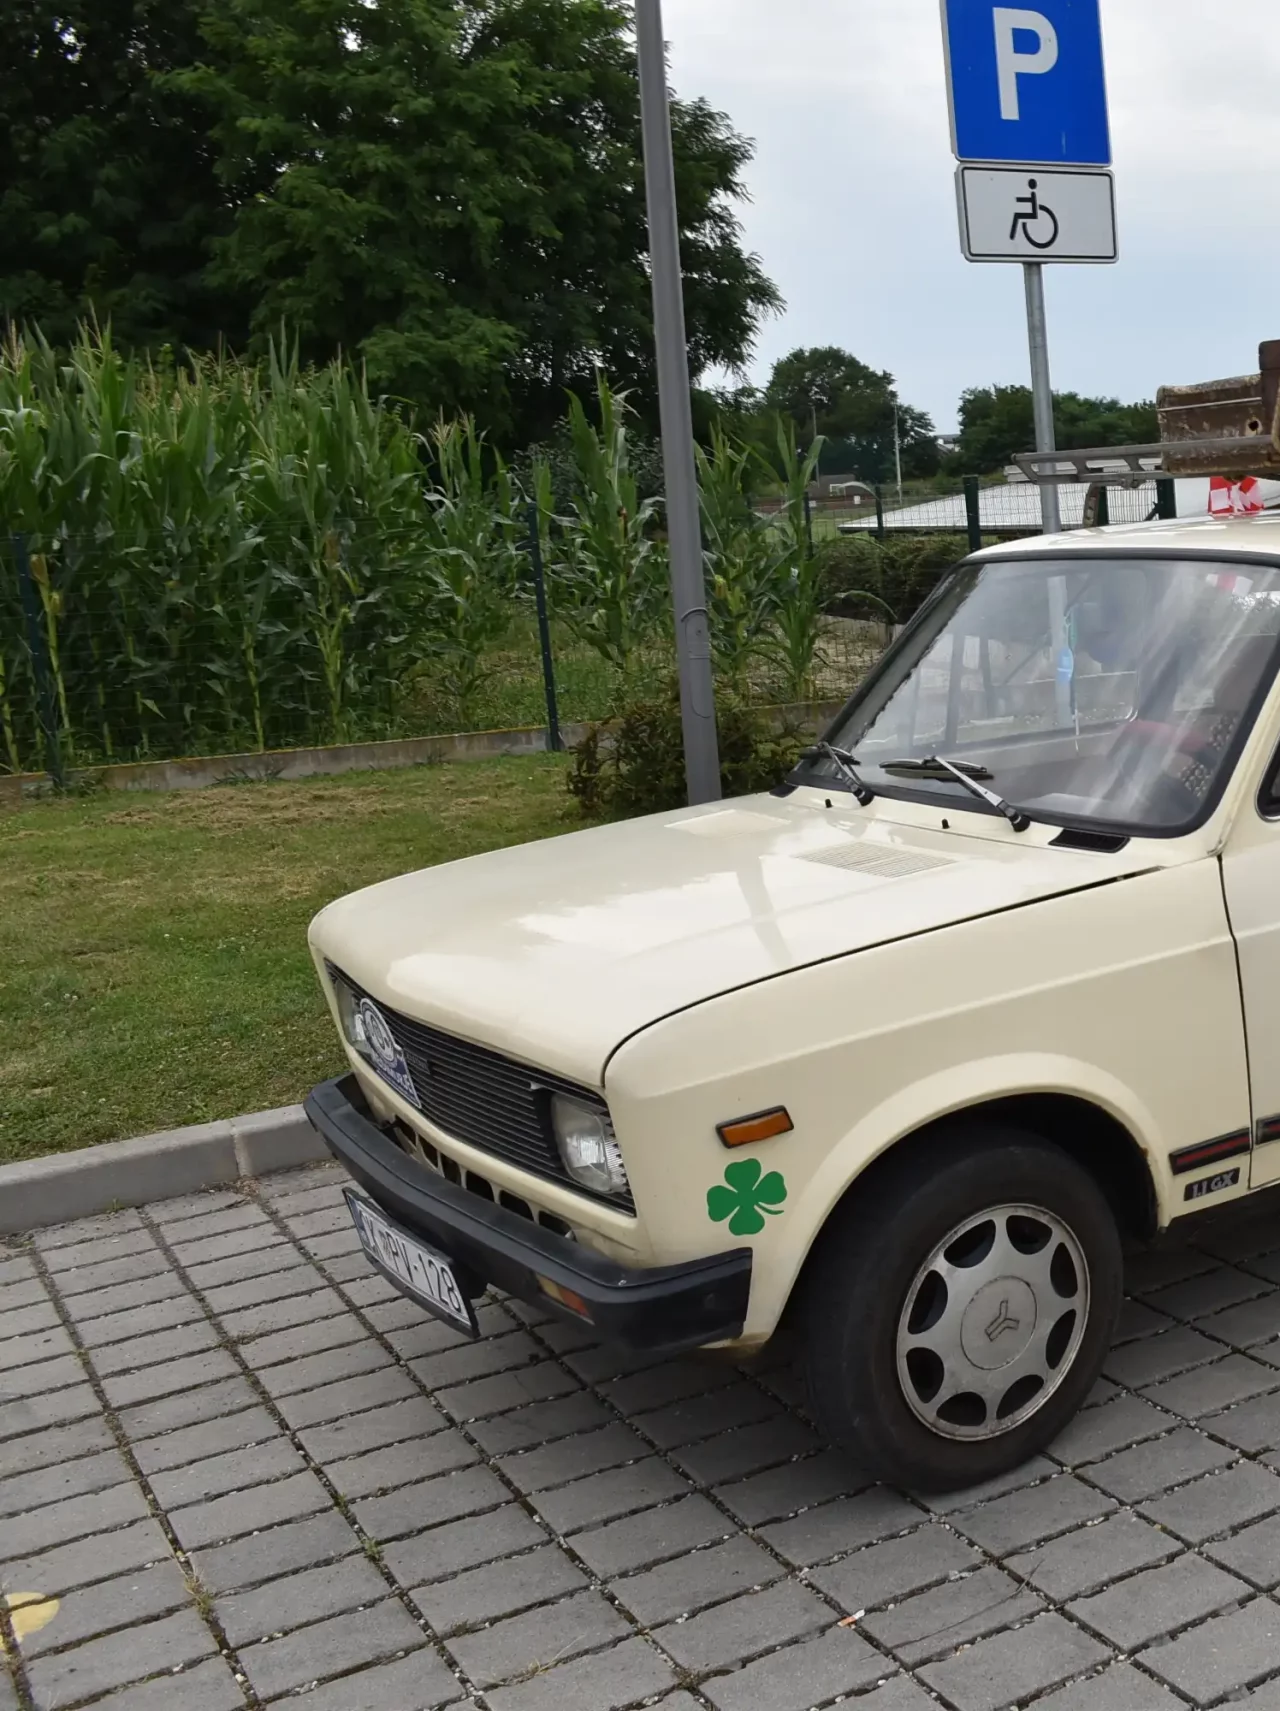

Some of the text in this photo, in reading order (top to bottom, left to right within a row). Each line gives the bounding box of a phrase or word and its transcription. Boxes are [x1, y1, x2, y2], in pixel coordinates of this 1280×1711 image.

[992, 7, 1059, 121] P
[1211, 1171, 1234, 1190] GX
[384, 1230, 461, 1314] PV-128
